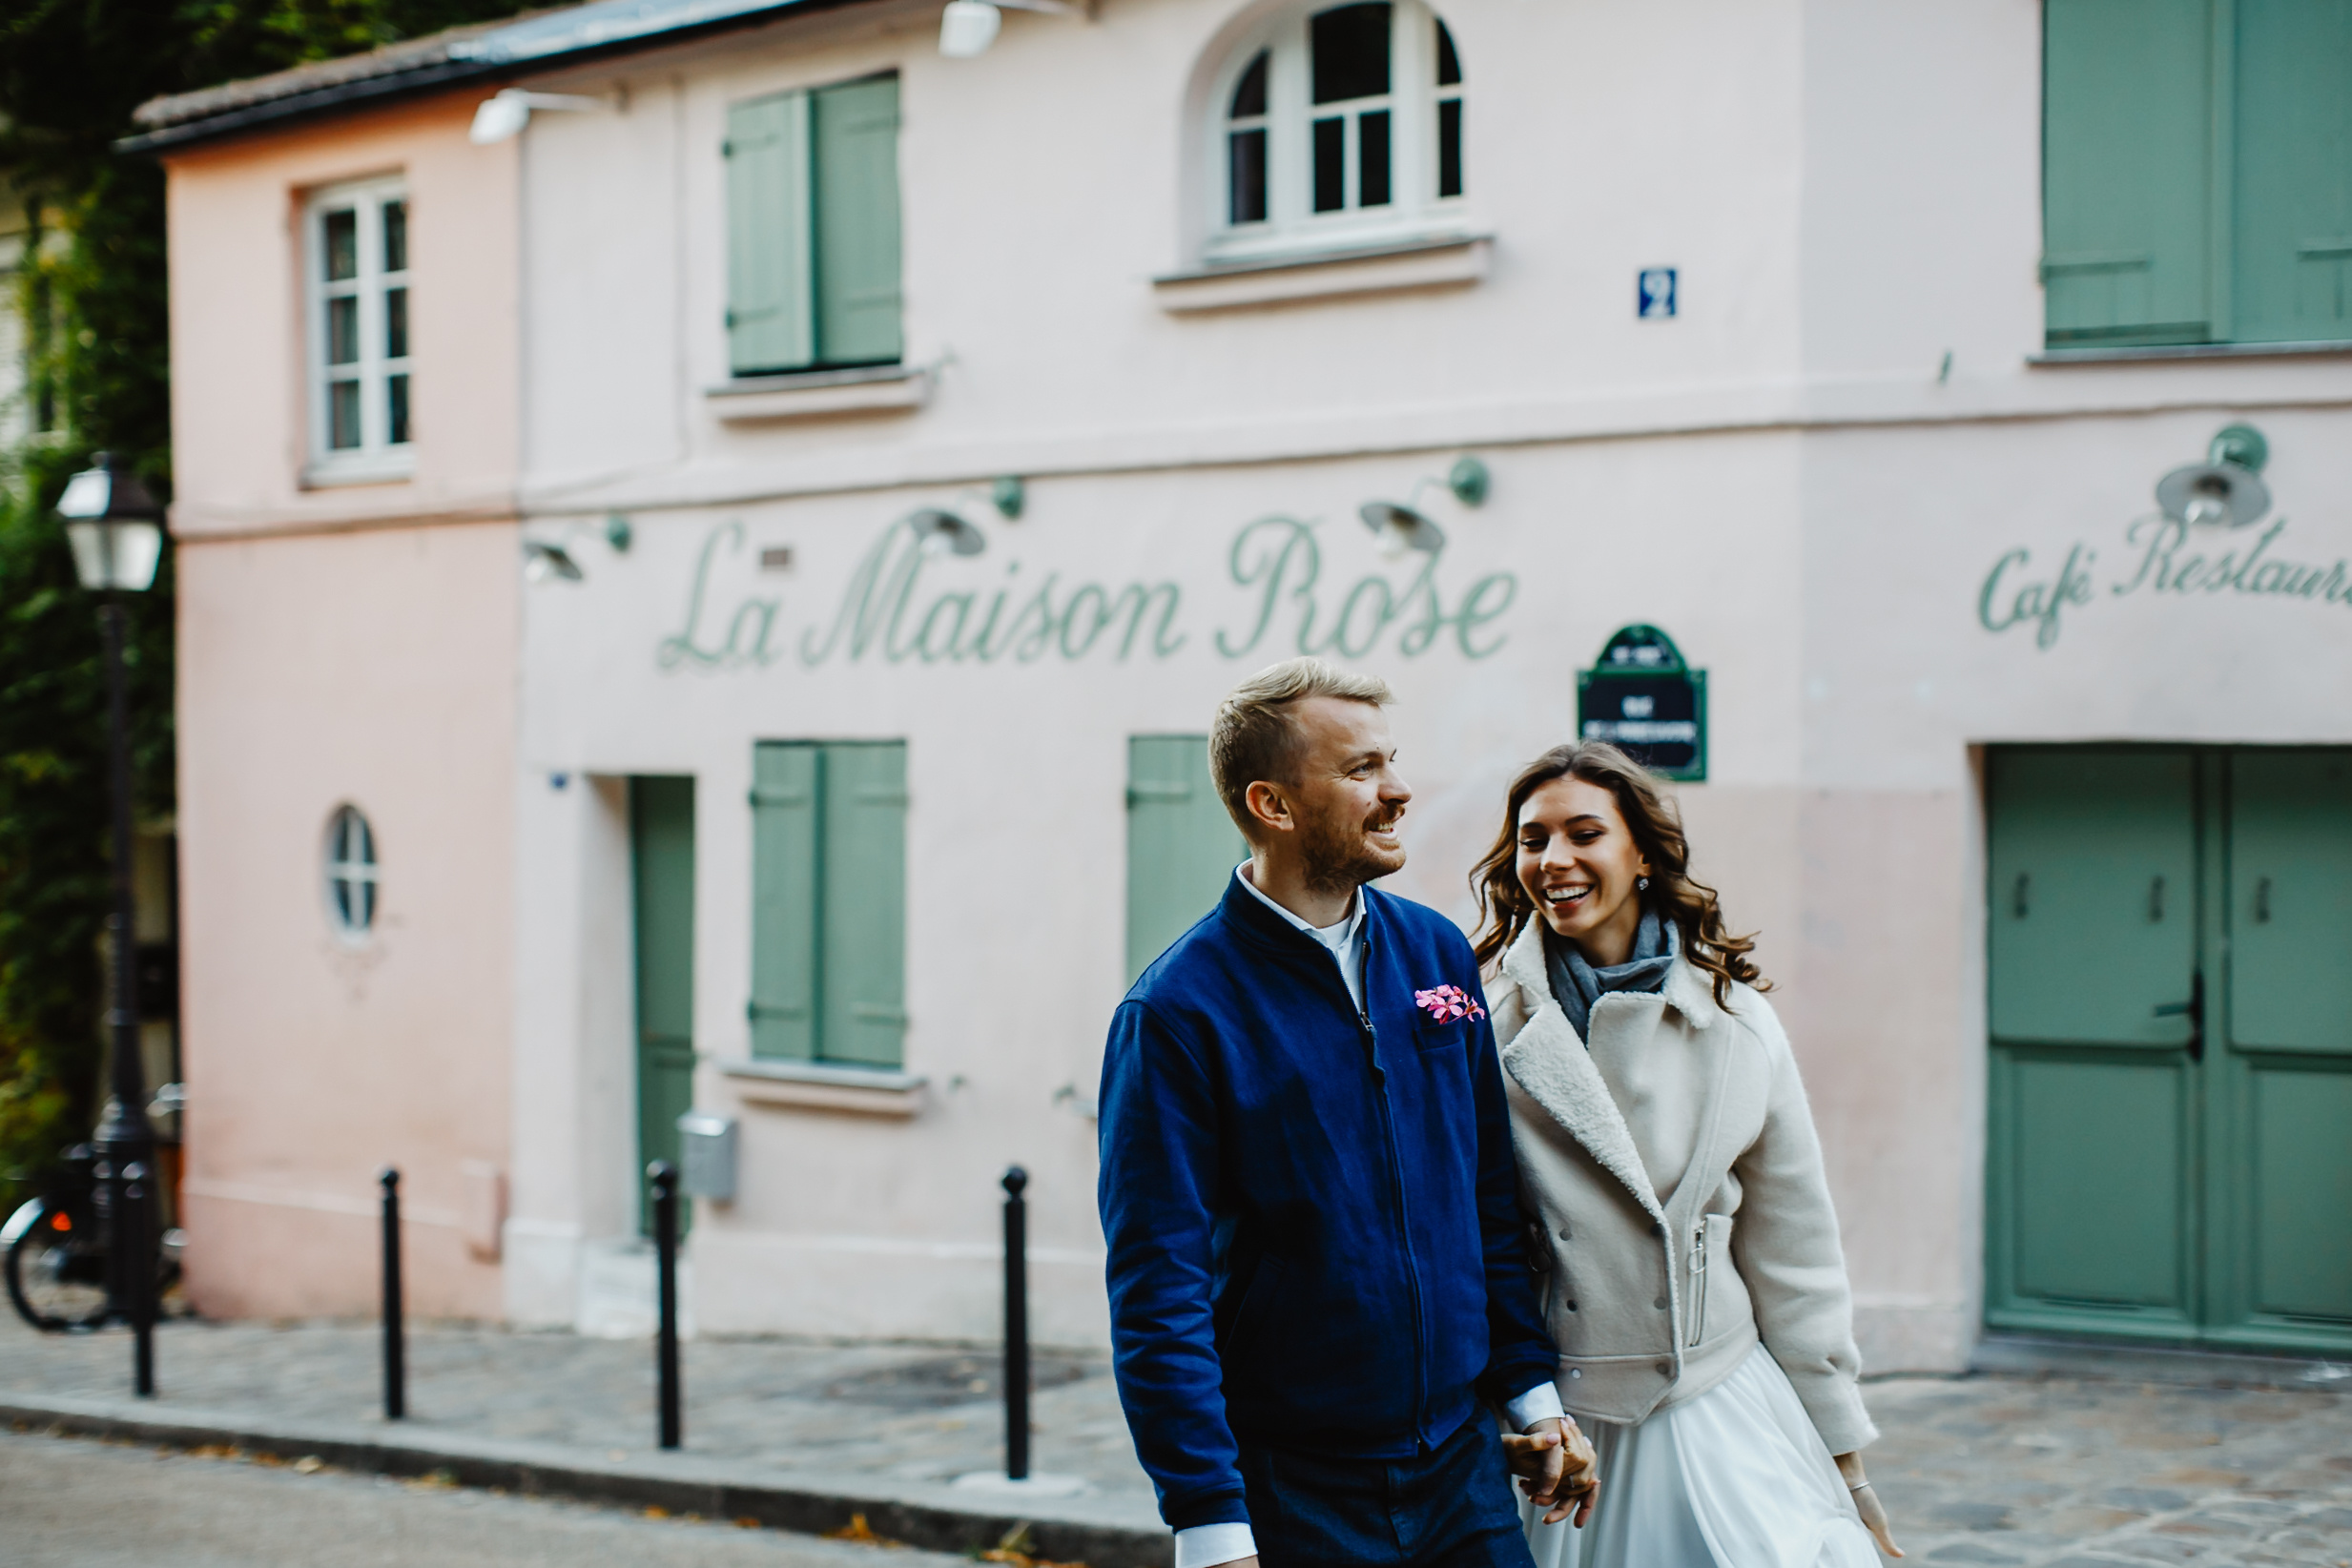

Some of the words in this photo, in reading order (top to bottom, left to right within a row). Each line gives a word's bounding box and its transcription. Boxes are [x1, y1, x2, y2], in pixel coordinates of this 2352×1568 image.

[657, 520, 781, 672] La
[798, 508, 1186, 670] Maison
[1214, 514, 1517, 660] Rose
